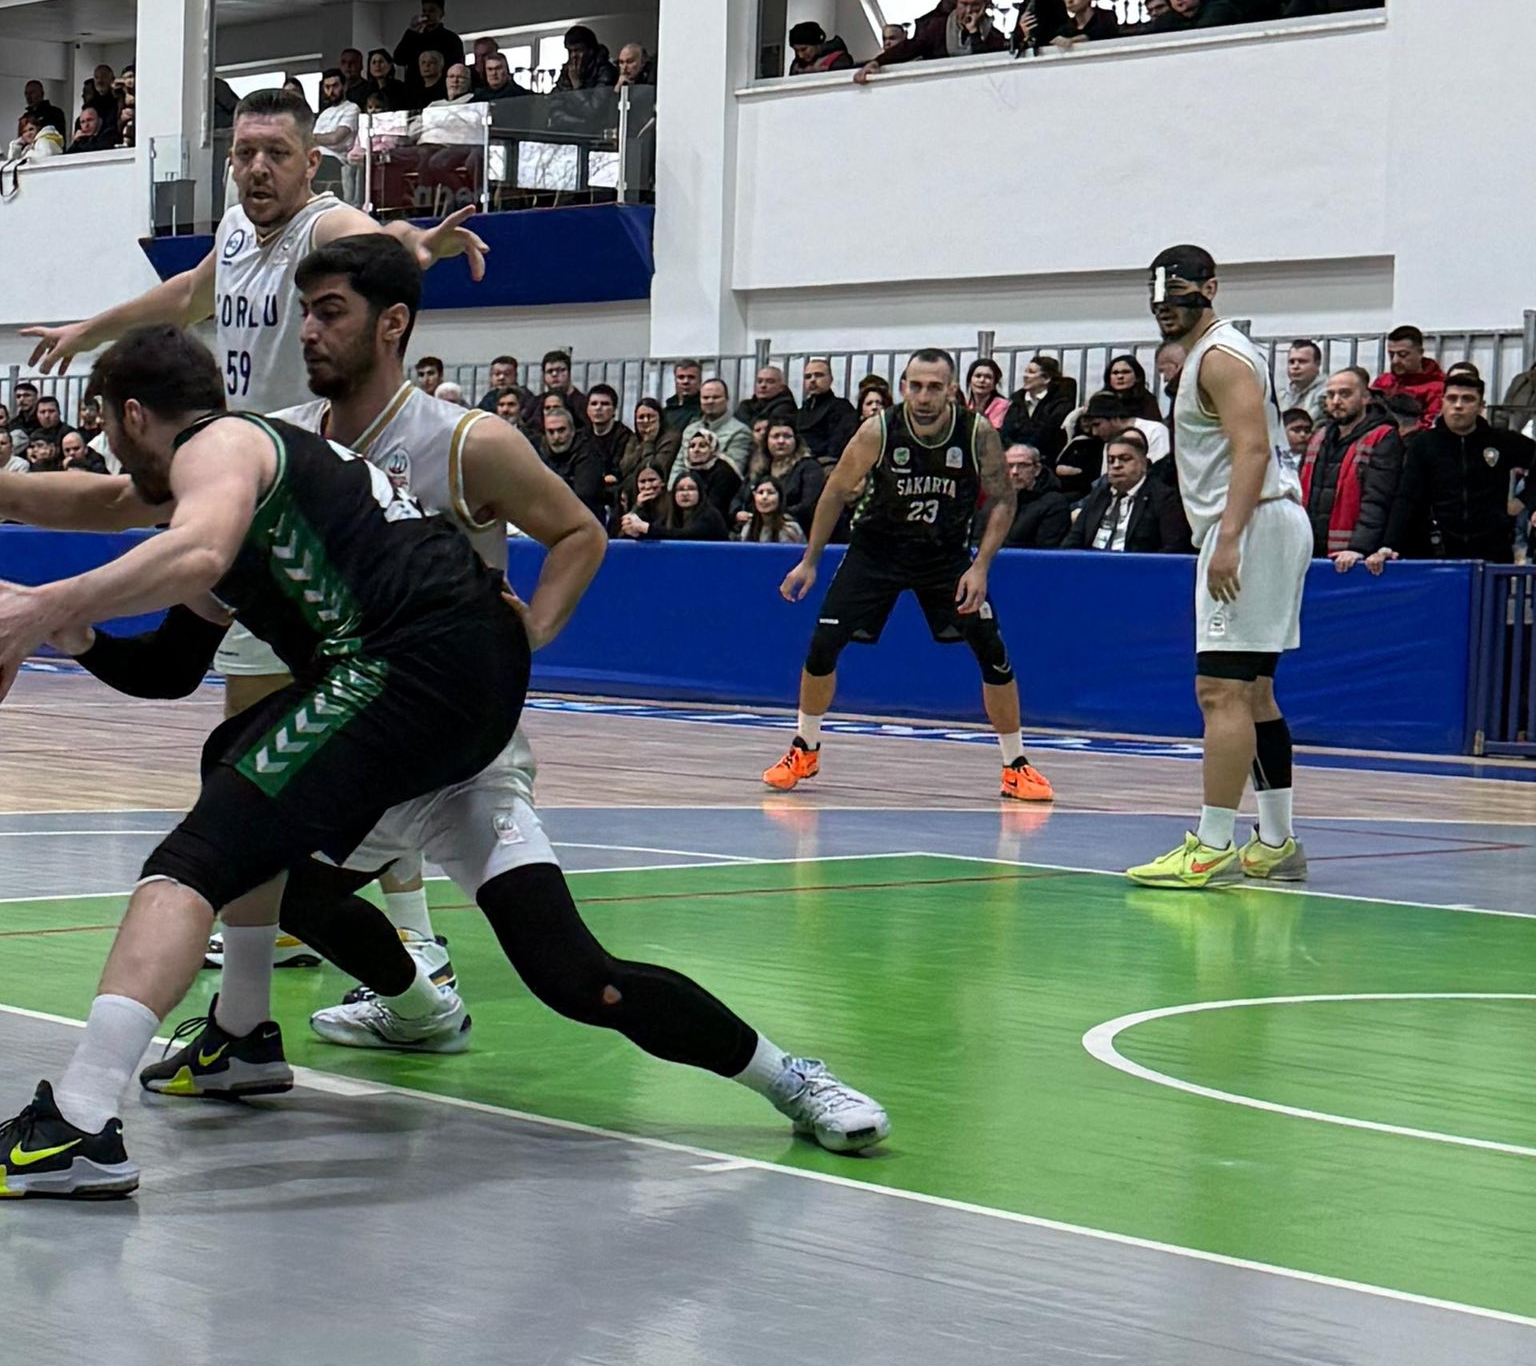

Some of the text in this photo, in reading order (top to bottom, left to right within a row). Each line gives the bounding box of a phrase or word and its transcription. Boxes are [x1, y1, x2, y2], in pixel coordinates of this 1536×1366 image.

[216, 294, 278, 327] ORLU
[227, 350, 251, 396] 59
[897, 476, 956, 498] SAKARYA
[907, 500, 939, 524] 23
